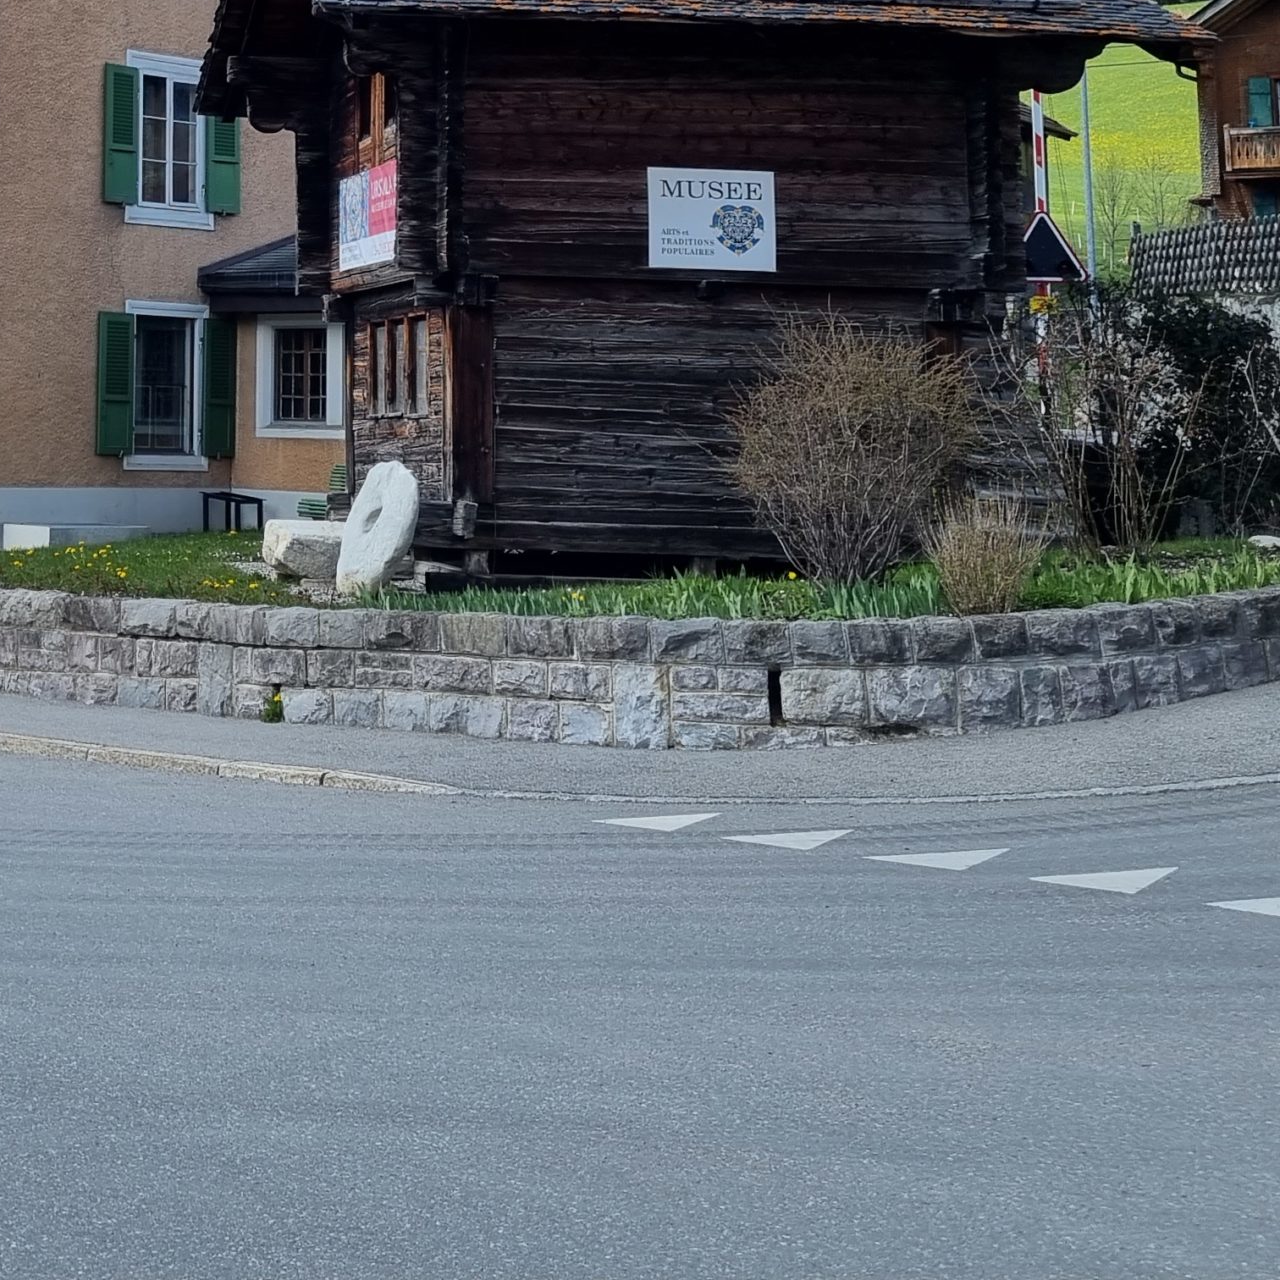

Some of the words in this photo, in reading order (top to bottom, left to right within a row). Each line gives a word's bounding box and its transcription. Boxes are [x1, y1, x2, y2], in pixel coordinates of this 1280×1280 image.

[659, 179, 763, 201] MUSEE
[661, 228, 680, 236] ARTS
[661, 237, 715, 246] TRADITIONS
[661, 247, 715, 256] POPULAIRES
